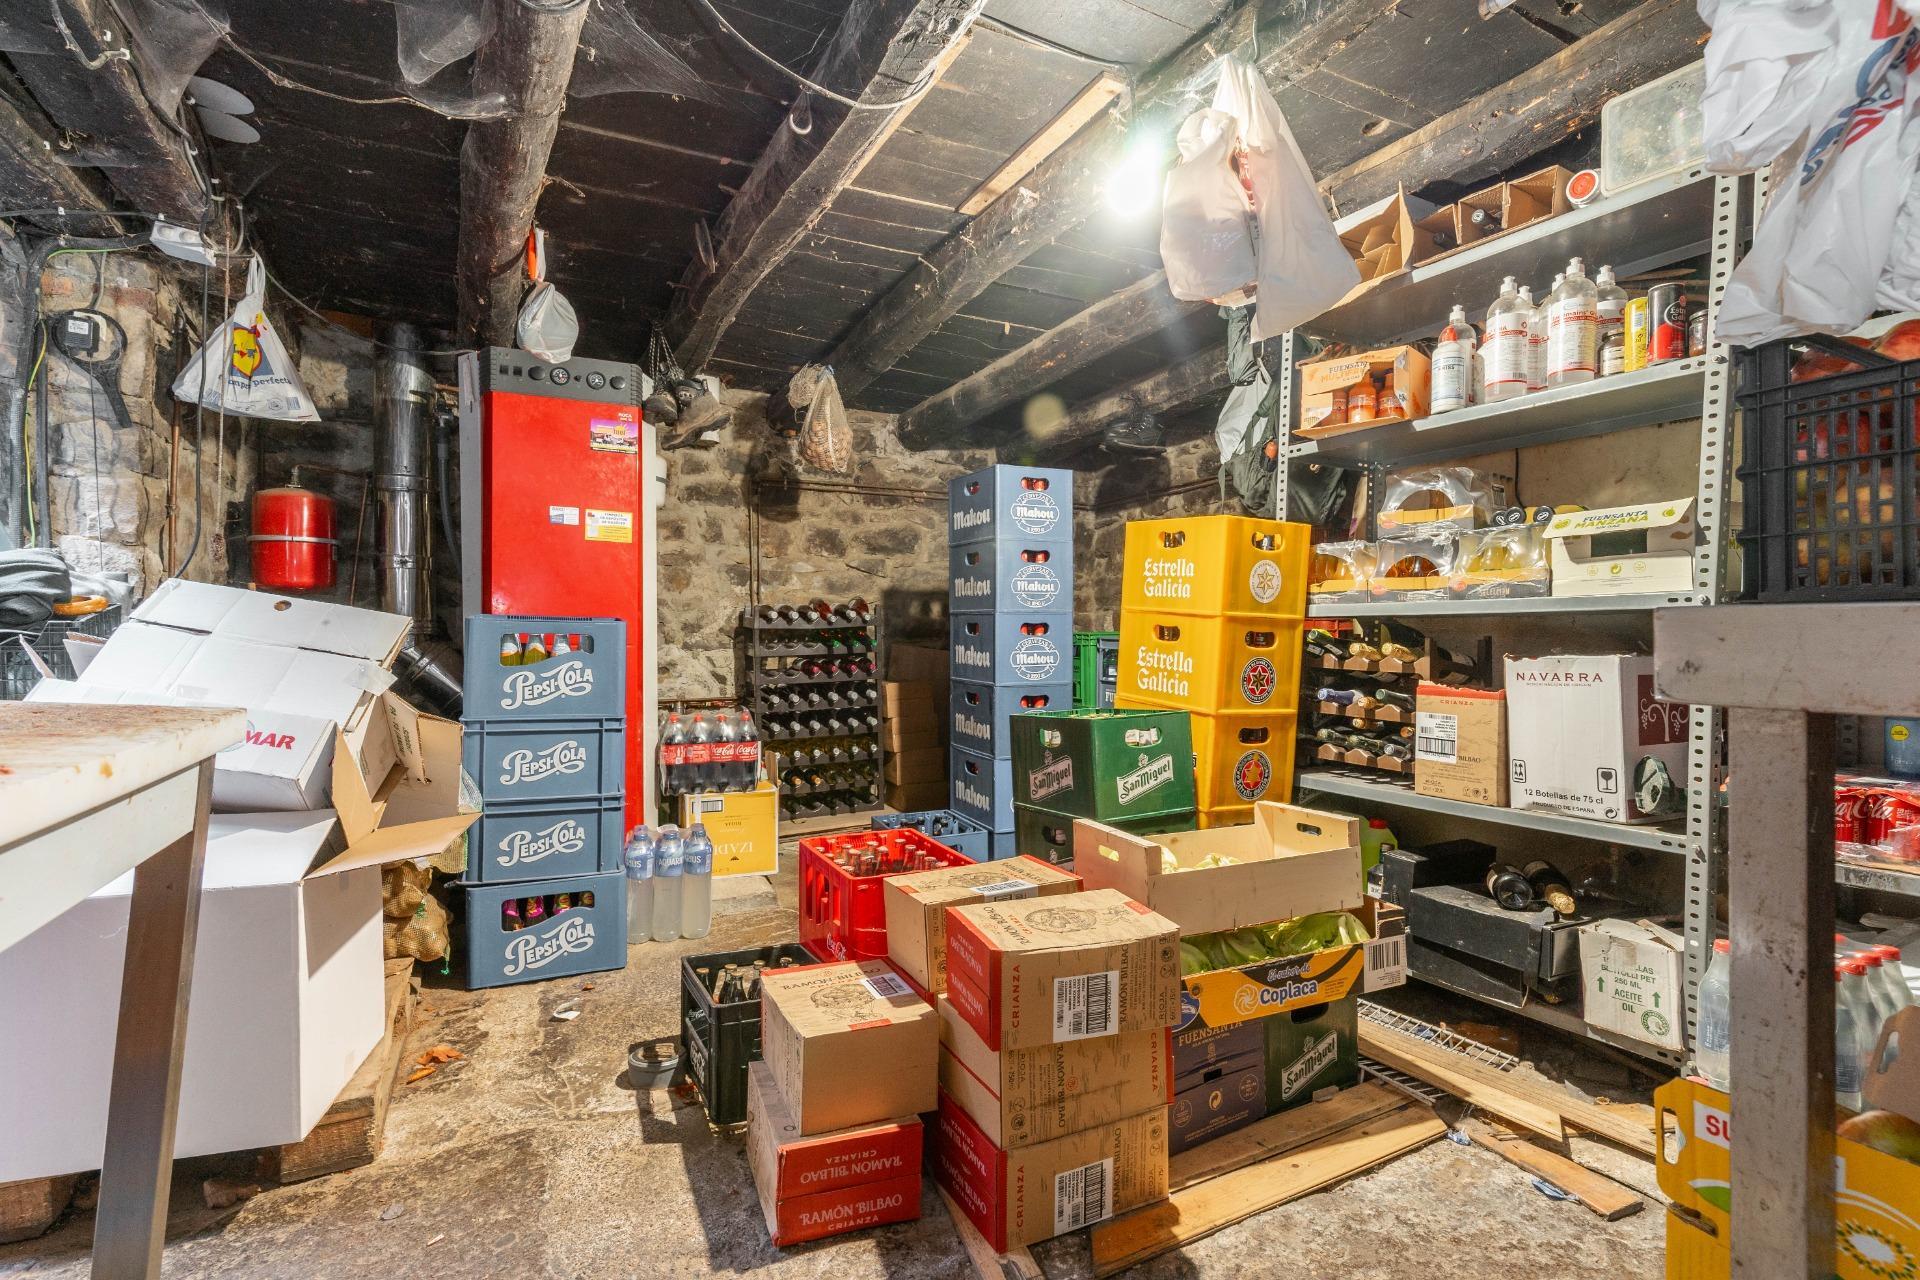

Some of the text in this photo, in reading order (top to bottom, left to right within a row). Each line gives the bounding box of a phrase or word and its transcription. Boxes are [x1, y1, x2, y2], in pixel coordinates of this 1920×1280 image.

[953, 508, 991, 530] Mahou
[1016, 506, 1054, 518] Mahou
[1574, 515, 1649, 529] MANZANA
[1583, 510, 1649, 523] FUENSANTA
[1143, 558, 1195, 577] Estrella
[954, 576, 992, 598] Mahou
[1017, 580, 1055, 592] Mahou
[1144, 577, 1191, 598] Galicia
[955, 644, 991, 668] Mahou
[1016, 653, 1054, 665] Mahou
[1136, 646, 1193, 673] Estrella
[1137, 668, 1190, 697] Galicia
[1516, 672, 1603, 683] NAVARRA
[955, 713, 991, 740] Mahou
[955, 780, 990, 812] Mahou
[1524, 788, 1604, 805] 12 Botellas de 75 cl
[1614, 976, 1642, 990] 250 ML
[1640, 974, 1656, 984] PET
[1012, 964, 1021, 1029] CRIANZA
[1260, 980, 1319, 1006] Coplaca
[1614, 988, 1643, 1003] ACEITE
[1622, 1002, 1636, 1014] OIL
[1150, 1032, 1159, 1093] CRIANZA
[826, 1149, 877, 1165] CRIANZA
[800, 1155, 903, 1184] RAMÓN BILBAO
[1016, 1165, 1025, 1228] CRIANZA
[800, 1193, 903, 1226] RAMÓN BILBAO
[828, 1215, 879, 1231] CRIANZA
